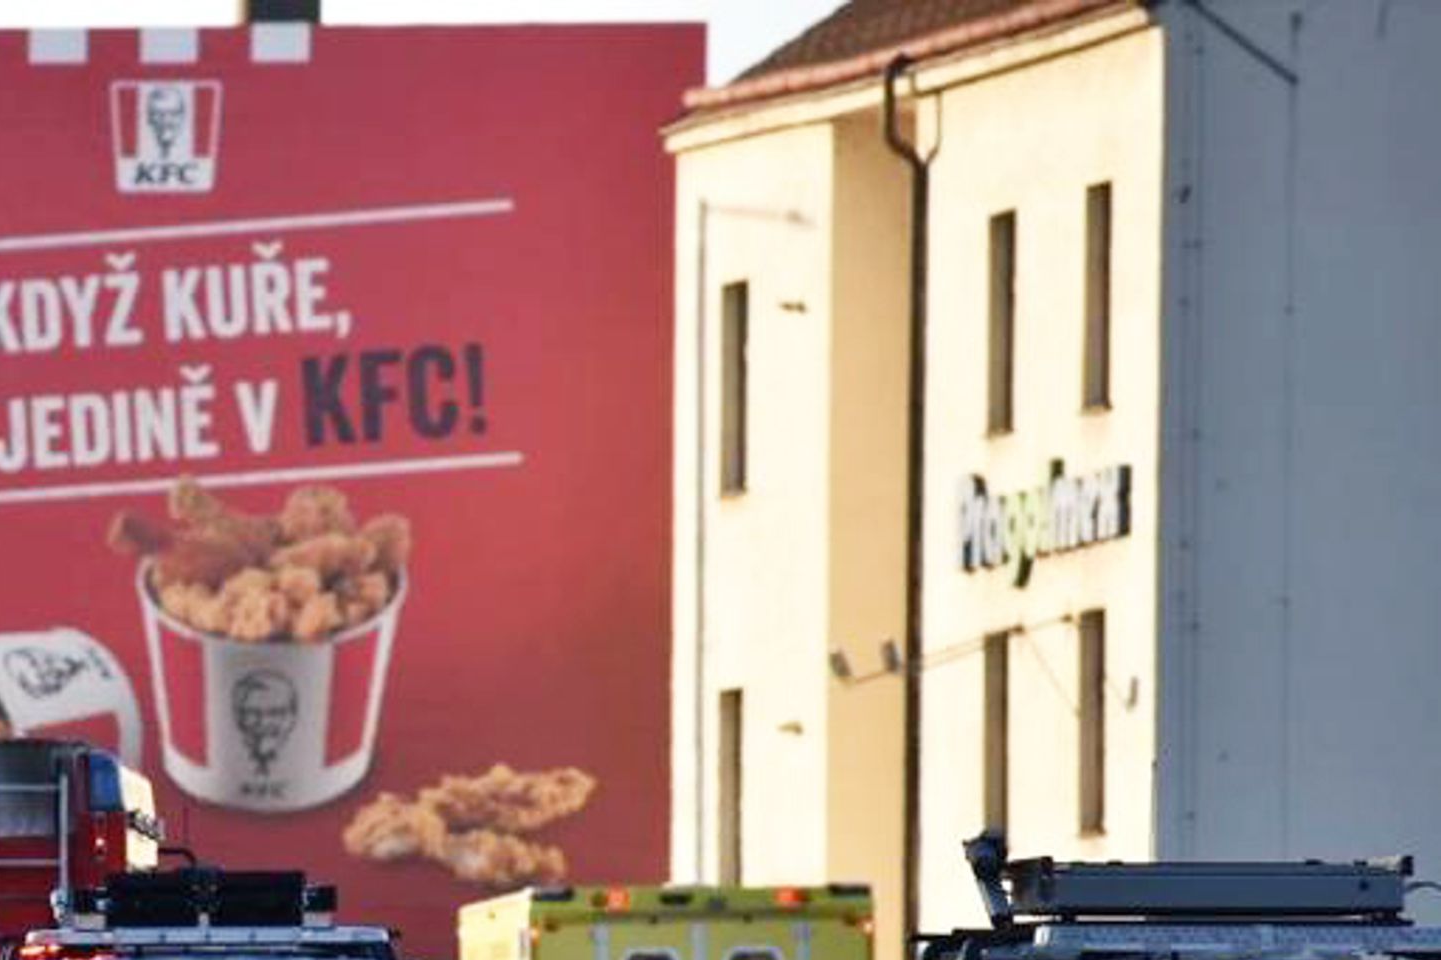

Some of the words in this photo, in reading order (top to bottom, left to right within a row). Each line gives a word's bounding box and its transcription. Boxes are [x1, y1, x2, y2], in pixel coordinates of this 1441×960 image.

[134, 162, 200, 185] KFC
[161, 239, 353, 343] KUŘE,
[235, 379, 279, 454] V
[300, 342, 488, 448] KFC!
